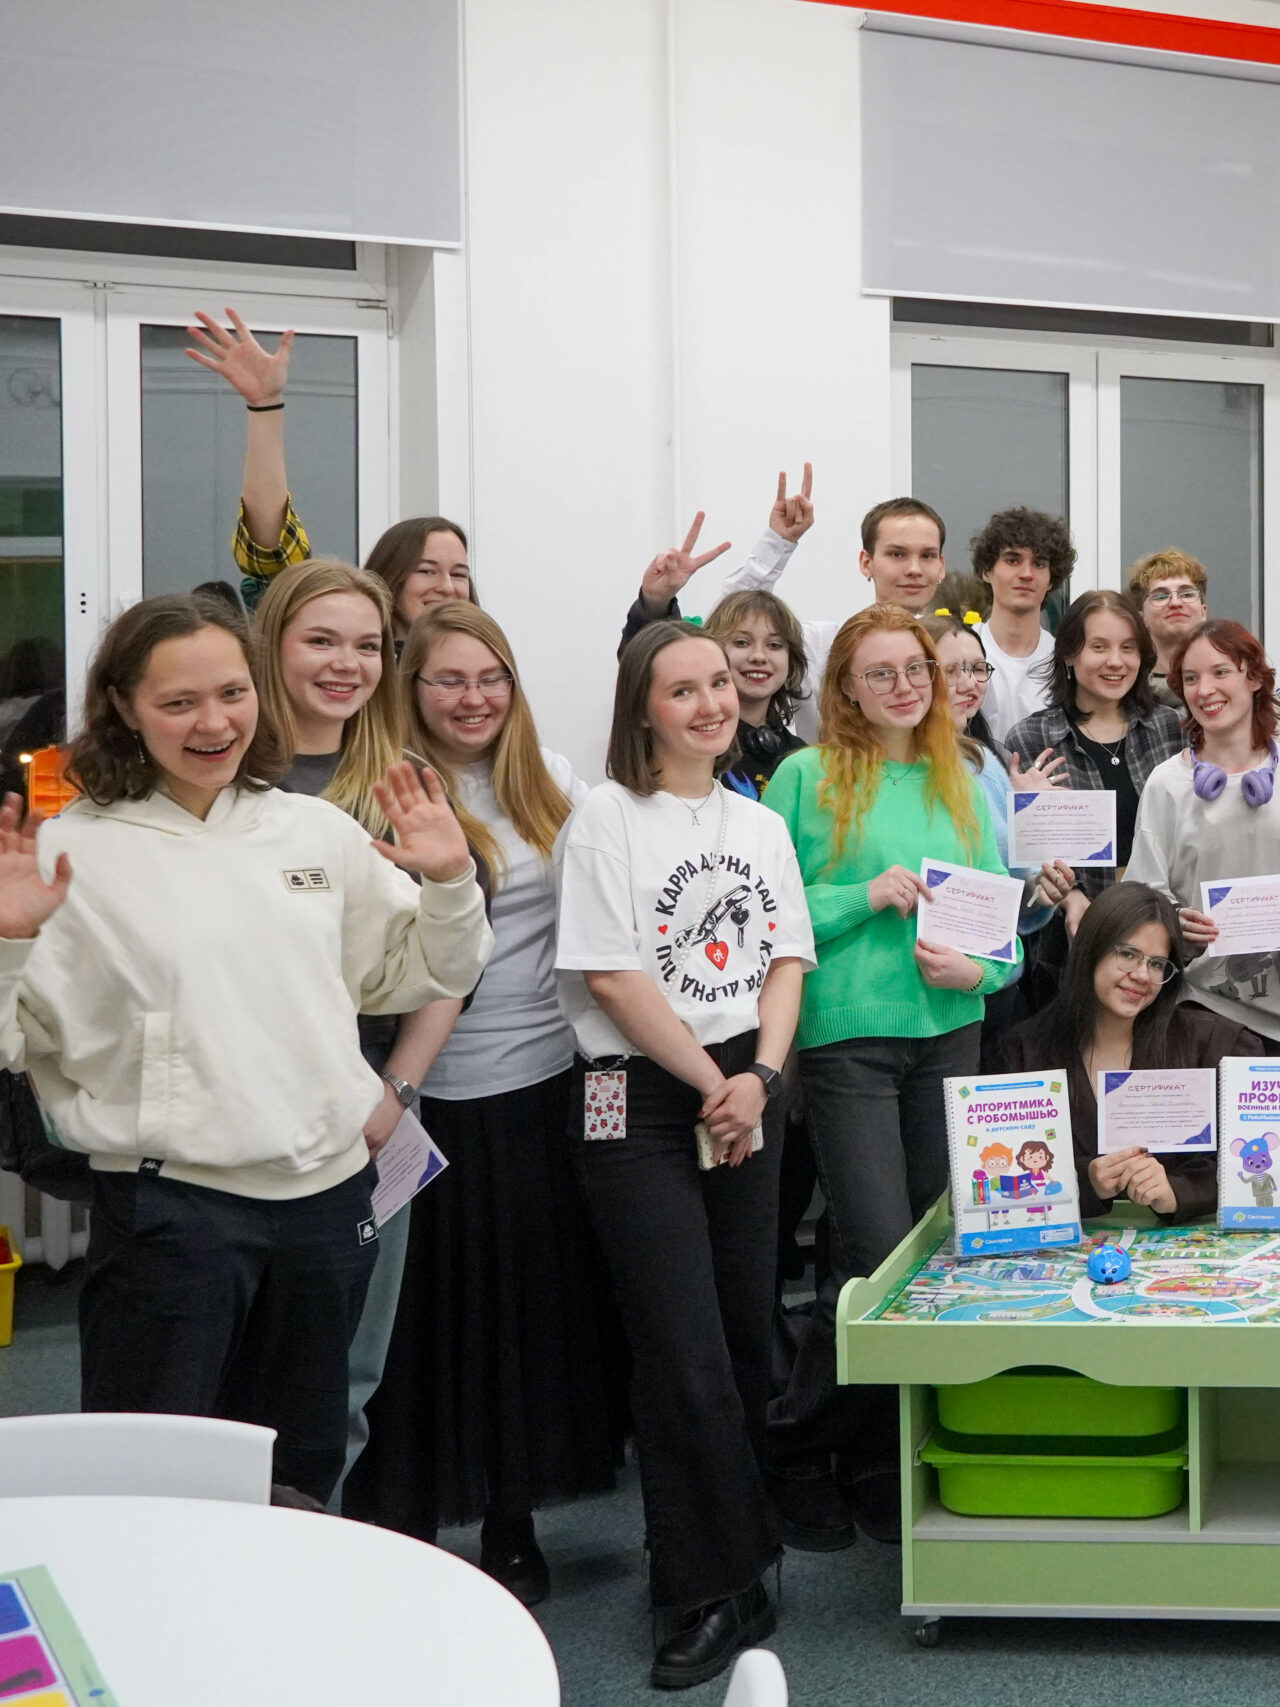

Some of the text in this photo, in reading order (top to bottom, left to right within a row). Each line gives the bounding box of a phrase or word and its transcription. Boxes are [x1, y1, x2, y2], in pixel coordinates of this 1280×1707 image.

[655, 860, 699, 916] KAPPA
[754, 875, 777, 913] TAU
[945, 886, 996, 903] СЕРТИФИКАТ
[1229, 895, 1279, 904] СЕРТИФИКАТ
[680, 973, 739, 1003] ALPHA
[1128, 1084, 1187, 1092] СЕРТИФИКАТ
[967, 1098, 1054, 1113] АЛГОРИТМИКА
[967, 1108, 1059, 1125] С РОБОМЫШЬЮ
[991, 1125, 1019, 1133] детском
